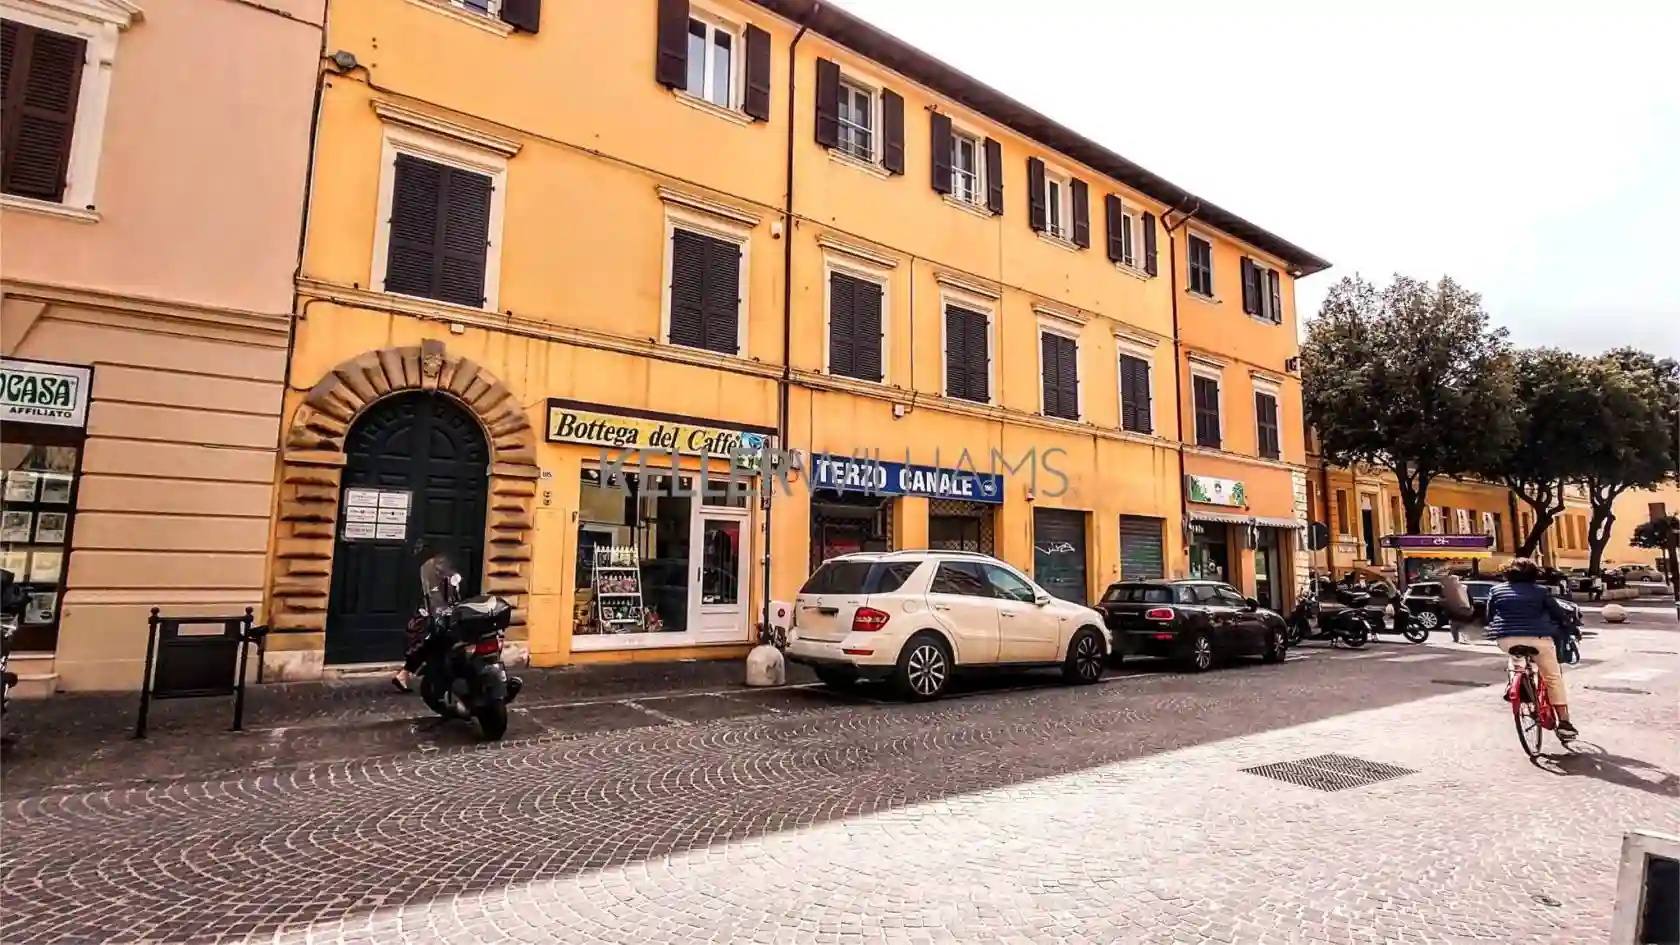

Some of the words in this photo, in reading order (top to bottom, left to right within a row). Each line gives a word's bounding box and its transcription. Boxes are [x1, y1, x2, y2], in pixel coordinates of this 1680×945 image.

[9, 406, 72, 418] AFFILIATO
[554, 412, 639, 446] Bottega
[649, 425, 680, 449] del
[817, 459, 887, 488] TERZO
[899, 468, 973, 496] CANALE
